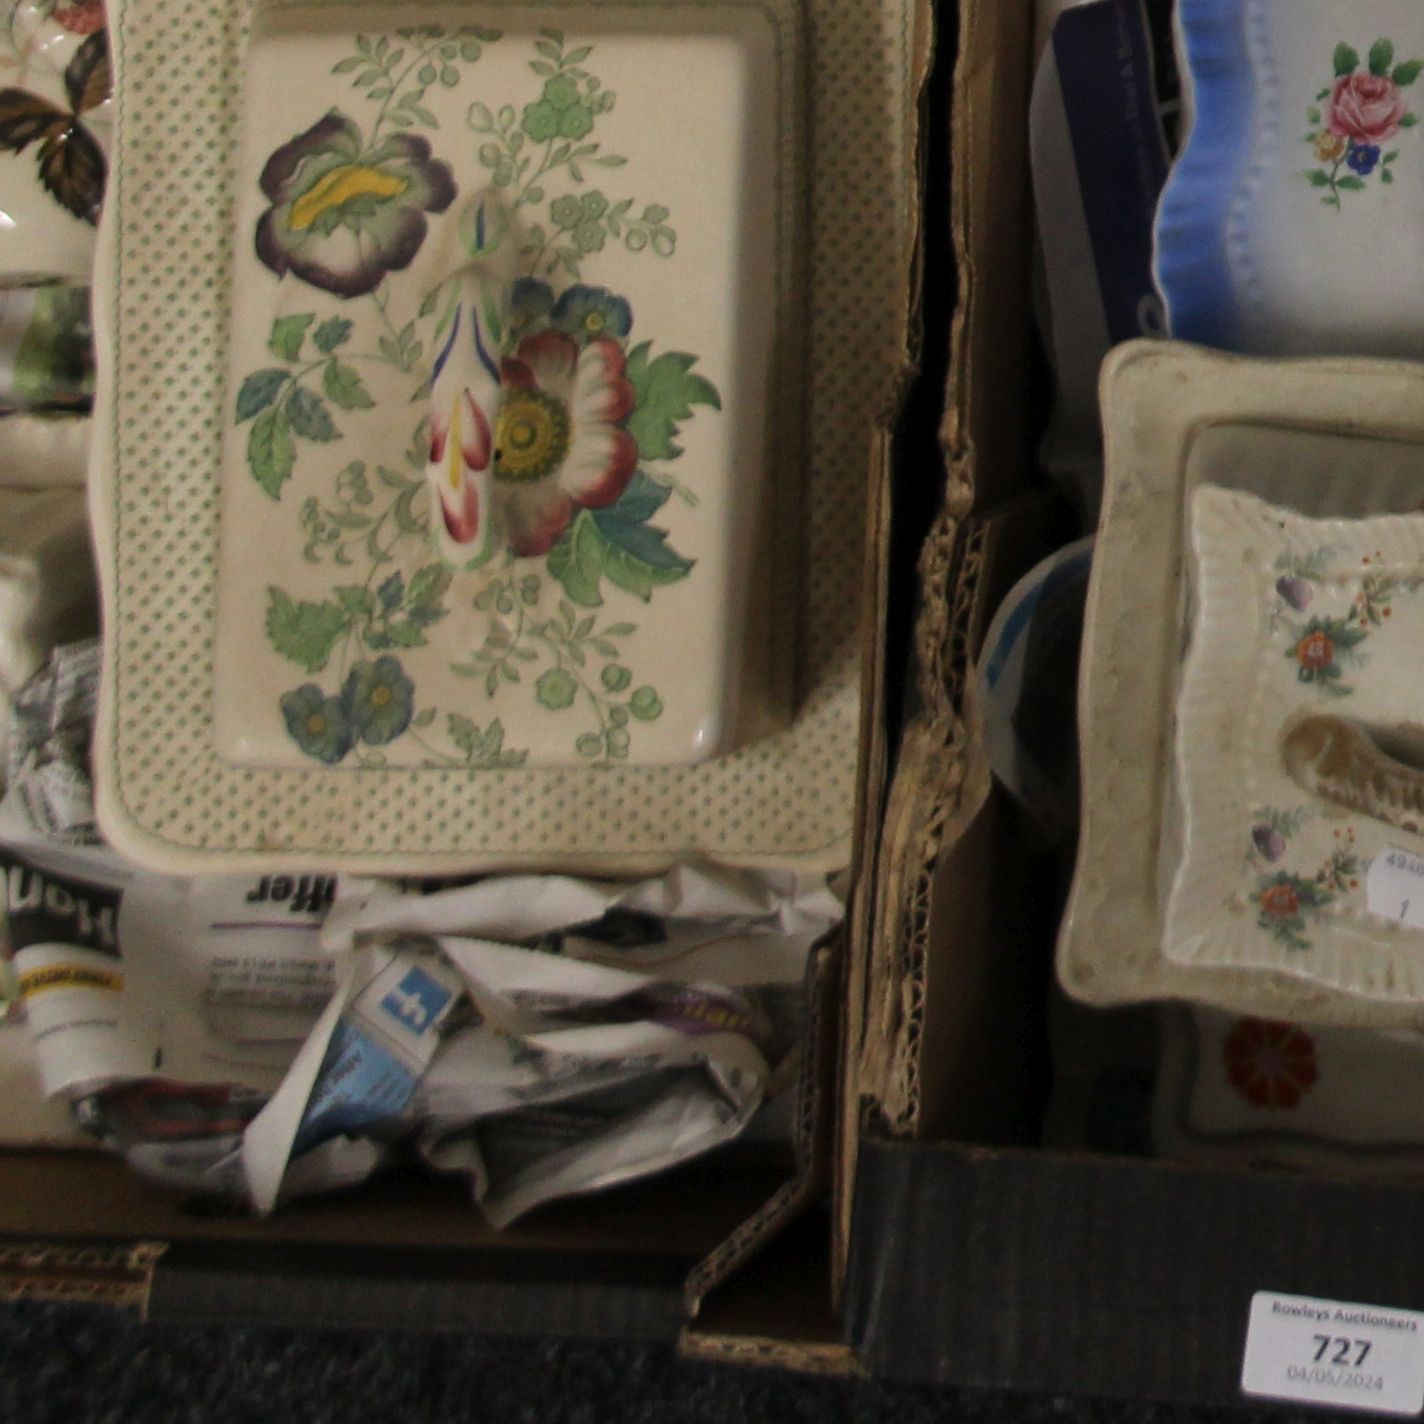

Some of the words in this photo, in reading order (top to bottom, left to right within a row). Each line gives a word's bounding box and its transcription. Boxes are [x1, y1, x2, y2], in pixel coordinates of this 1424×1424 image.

[1272, 1300, 1330, 1321] Rowleys
[1334, 1309, 1417, 1332] Auctioneers
[1312, 1334, 1373, 1366] 727
